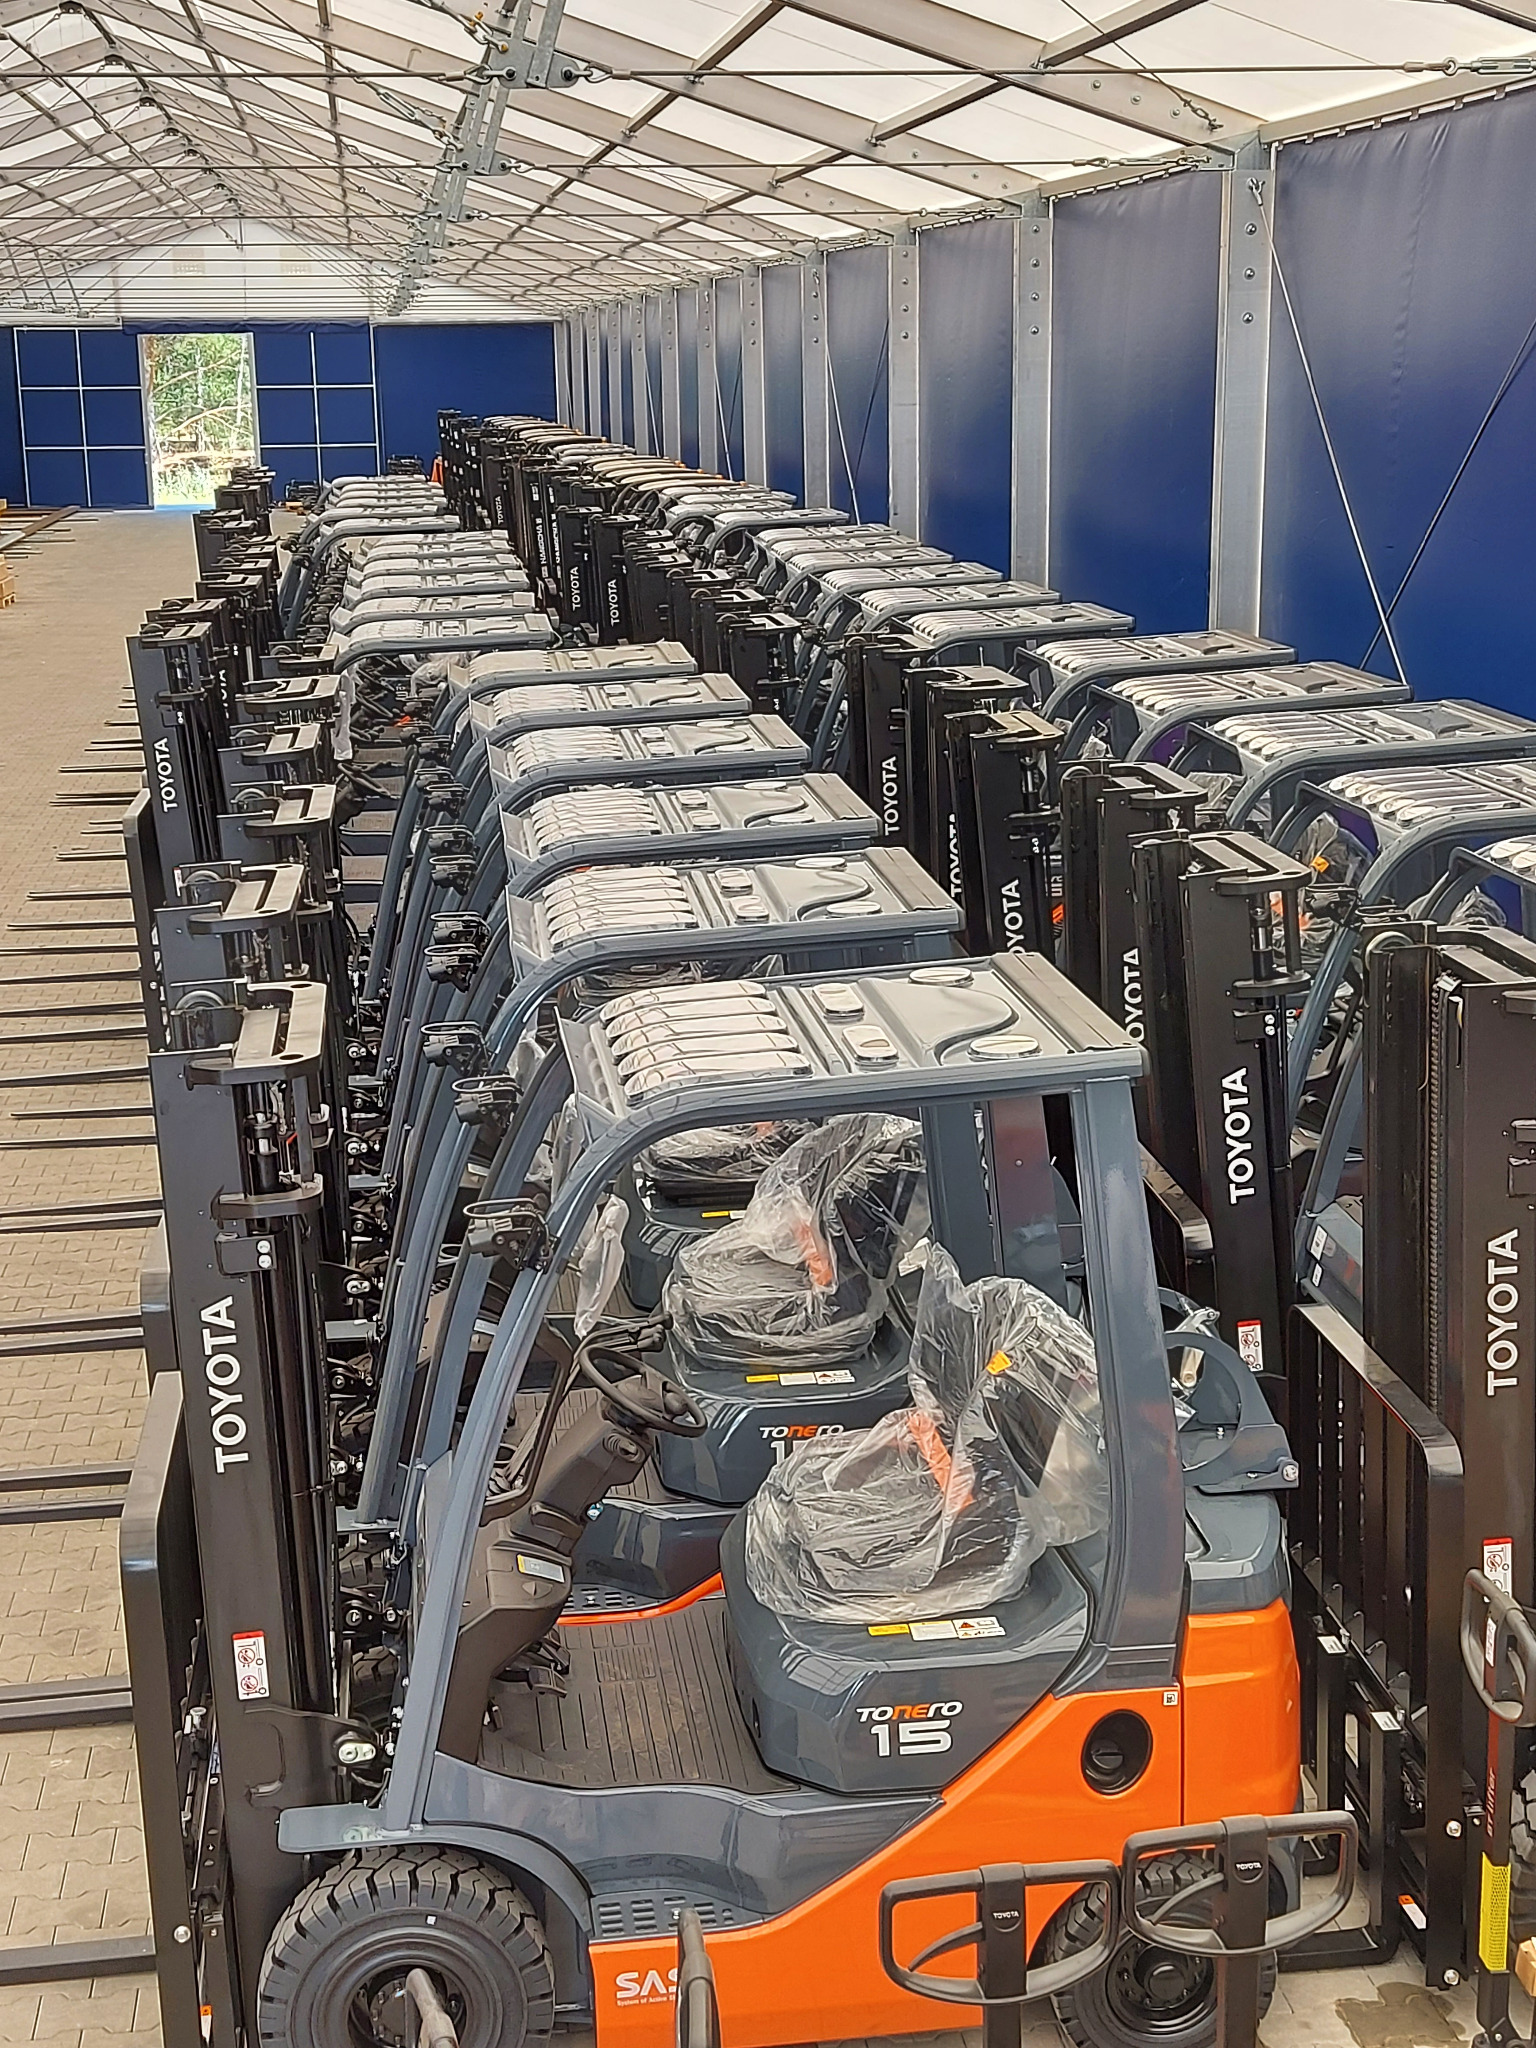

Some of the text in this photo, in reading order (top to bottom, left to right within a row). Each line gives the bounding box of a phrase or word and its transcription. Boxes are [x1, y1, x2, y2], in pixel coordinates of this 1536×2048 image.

[495, 496, 504, 525] TOYOTA
[570, 566, 581, 612] TOYOTA
[608, 579, 620, 627] TOYOTA
[154, 737, 179, 813] TOYOTA
[881, 756, 901, 836] TOYOTA
[1122, 948, 1145, 1043] OYOTA
[1221, 1066, 1256, 1205] TOYOTA
[1486, 1228, 1519, 1397] TOYOTA
[200, 1295, 250, 1475] TOYOTA
[870, 1719, 952, 1757] 15
[1235, 1862, 1262, 1870] TOYOTA
[992, 1911, 1020, 1919] TOYOTA
